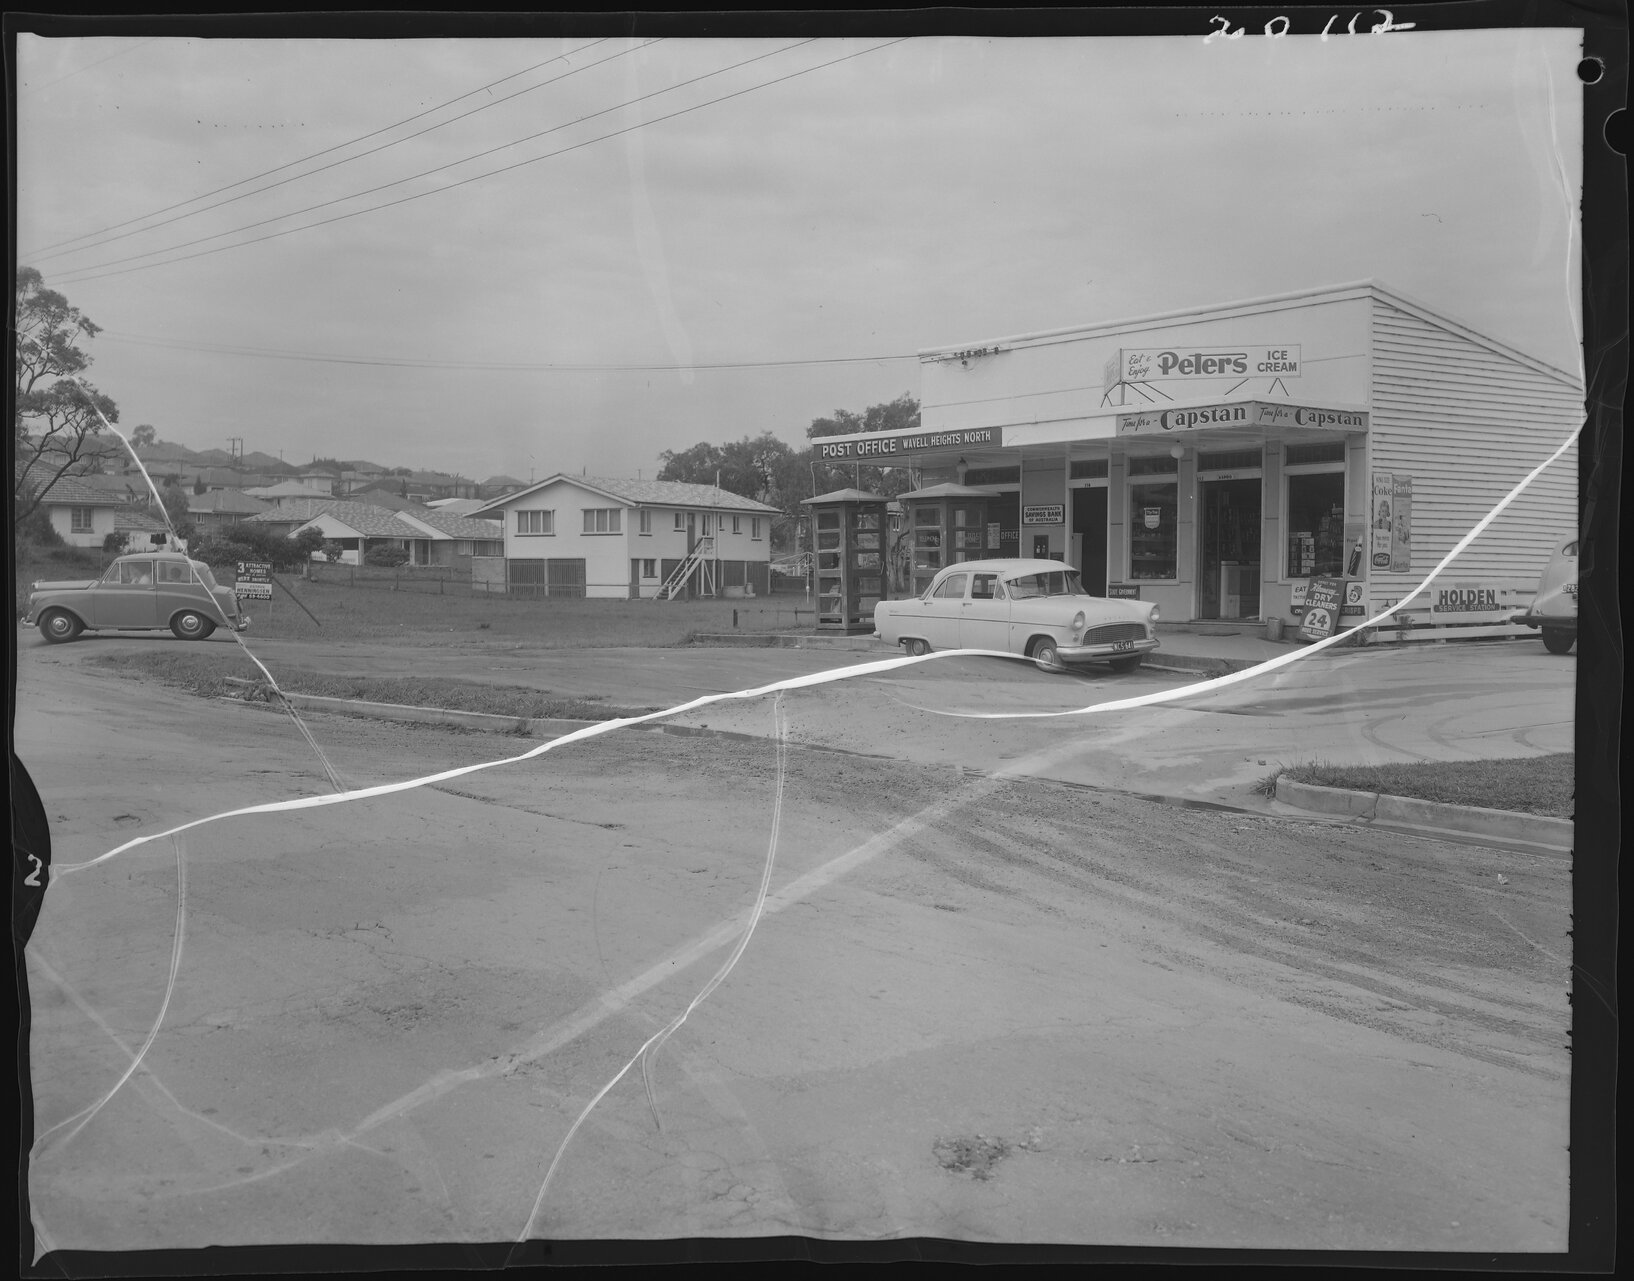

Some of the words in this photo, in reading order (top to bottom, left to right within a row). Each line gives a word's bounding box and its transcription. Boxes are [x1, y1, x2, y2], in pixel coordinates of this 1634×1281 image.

[1128, 354, 1142, 366] Eat
[1267, 350, 1288, 361] ICE
[1157, 351, 1248, 375] Peters
[1257, 361, 1297, 372] CREAM
[1121, 418, 1136, 431] Time
[1160, 406, 1247, 430] Capstan
[1258, 407, 1274, 421] Time
[1294, 408, 1363, 426] Capstan
[822, 442, 852, 458] POST
[857, 438, 897, 455] OFFICE
[902, 438, 929, 449] WAVELL
[930, 433, 961, 446] HEIGHTS
[964, 430, 991, 443] NORTH
[1374, 485, 1392, 496] Coke
[1000, 531, 1019, 540] OFFICE
[237, 562, 245, 573] 3
[1294, 585, 1307, 593] EAT
[1314, 592, 1333, 602] DRY
[1439, 589, 1496, 605] HOLDEN
[1305, 599, 1338, 610] CLEANERS
[1438, 604, 1466, 612] SERVICE
[1308, 612, 1328, 628] 24
[24, 853, 42, 886] 2
